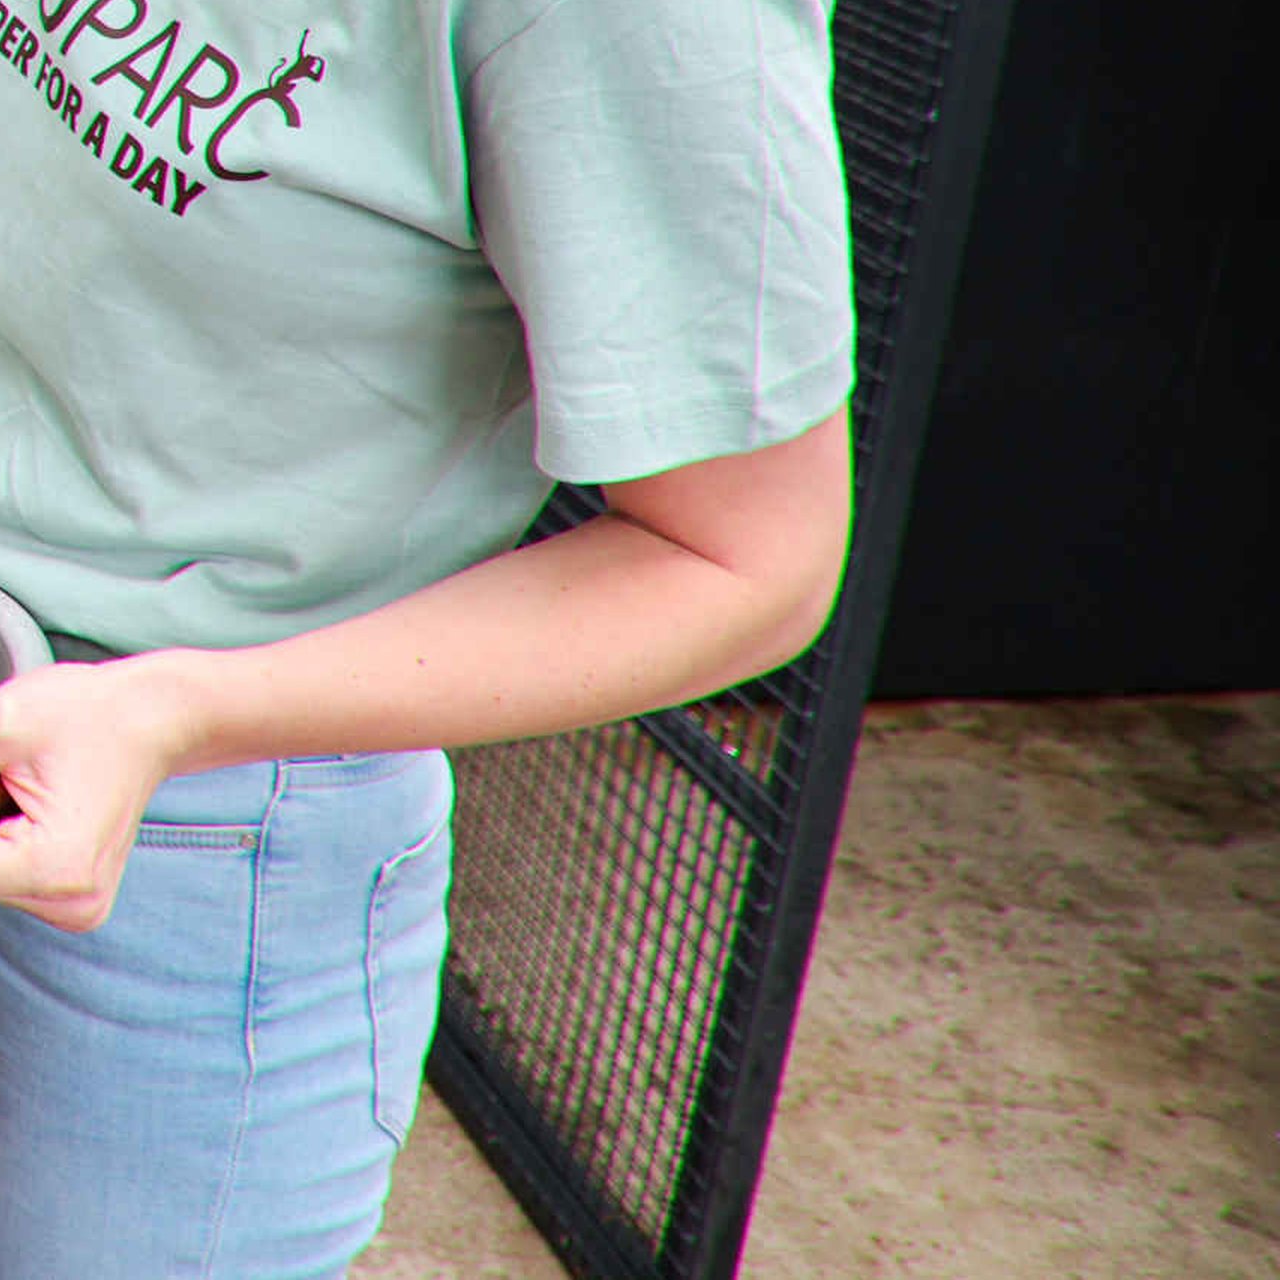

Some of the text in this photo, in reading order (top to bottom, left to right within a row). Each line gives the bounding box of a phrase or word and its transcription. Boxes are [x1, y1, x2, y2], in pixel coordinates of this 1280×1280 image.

[33, 52, 84, 134] FOR
[81, 111, 114, 160] A
[108, 131, 208, 217] DAY
